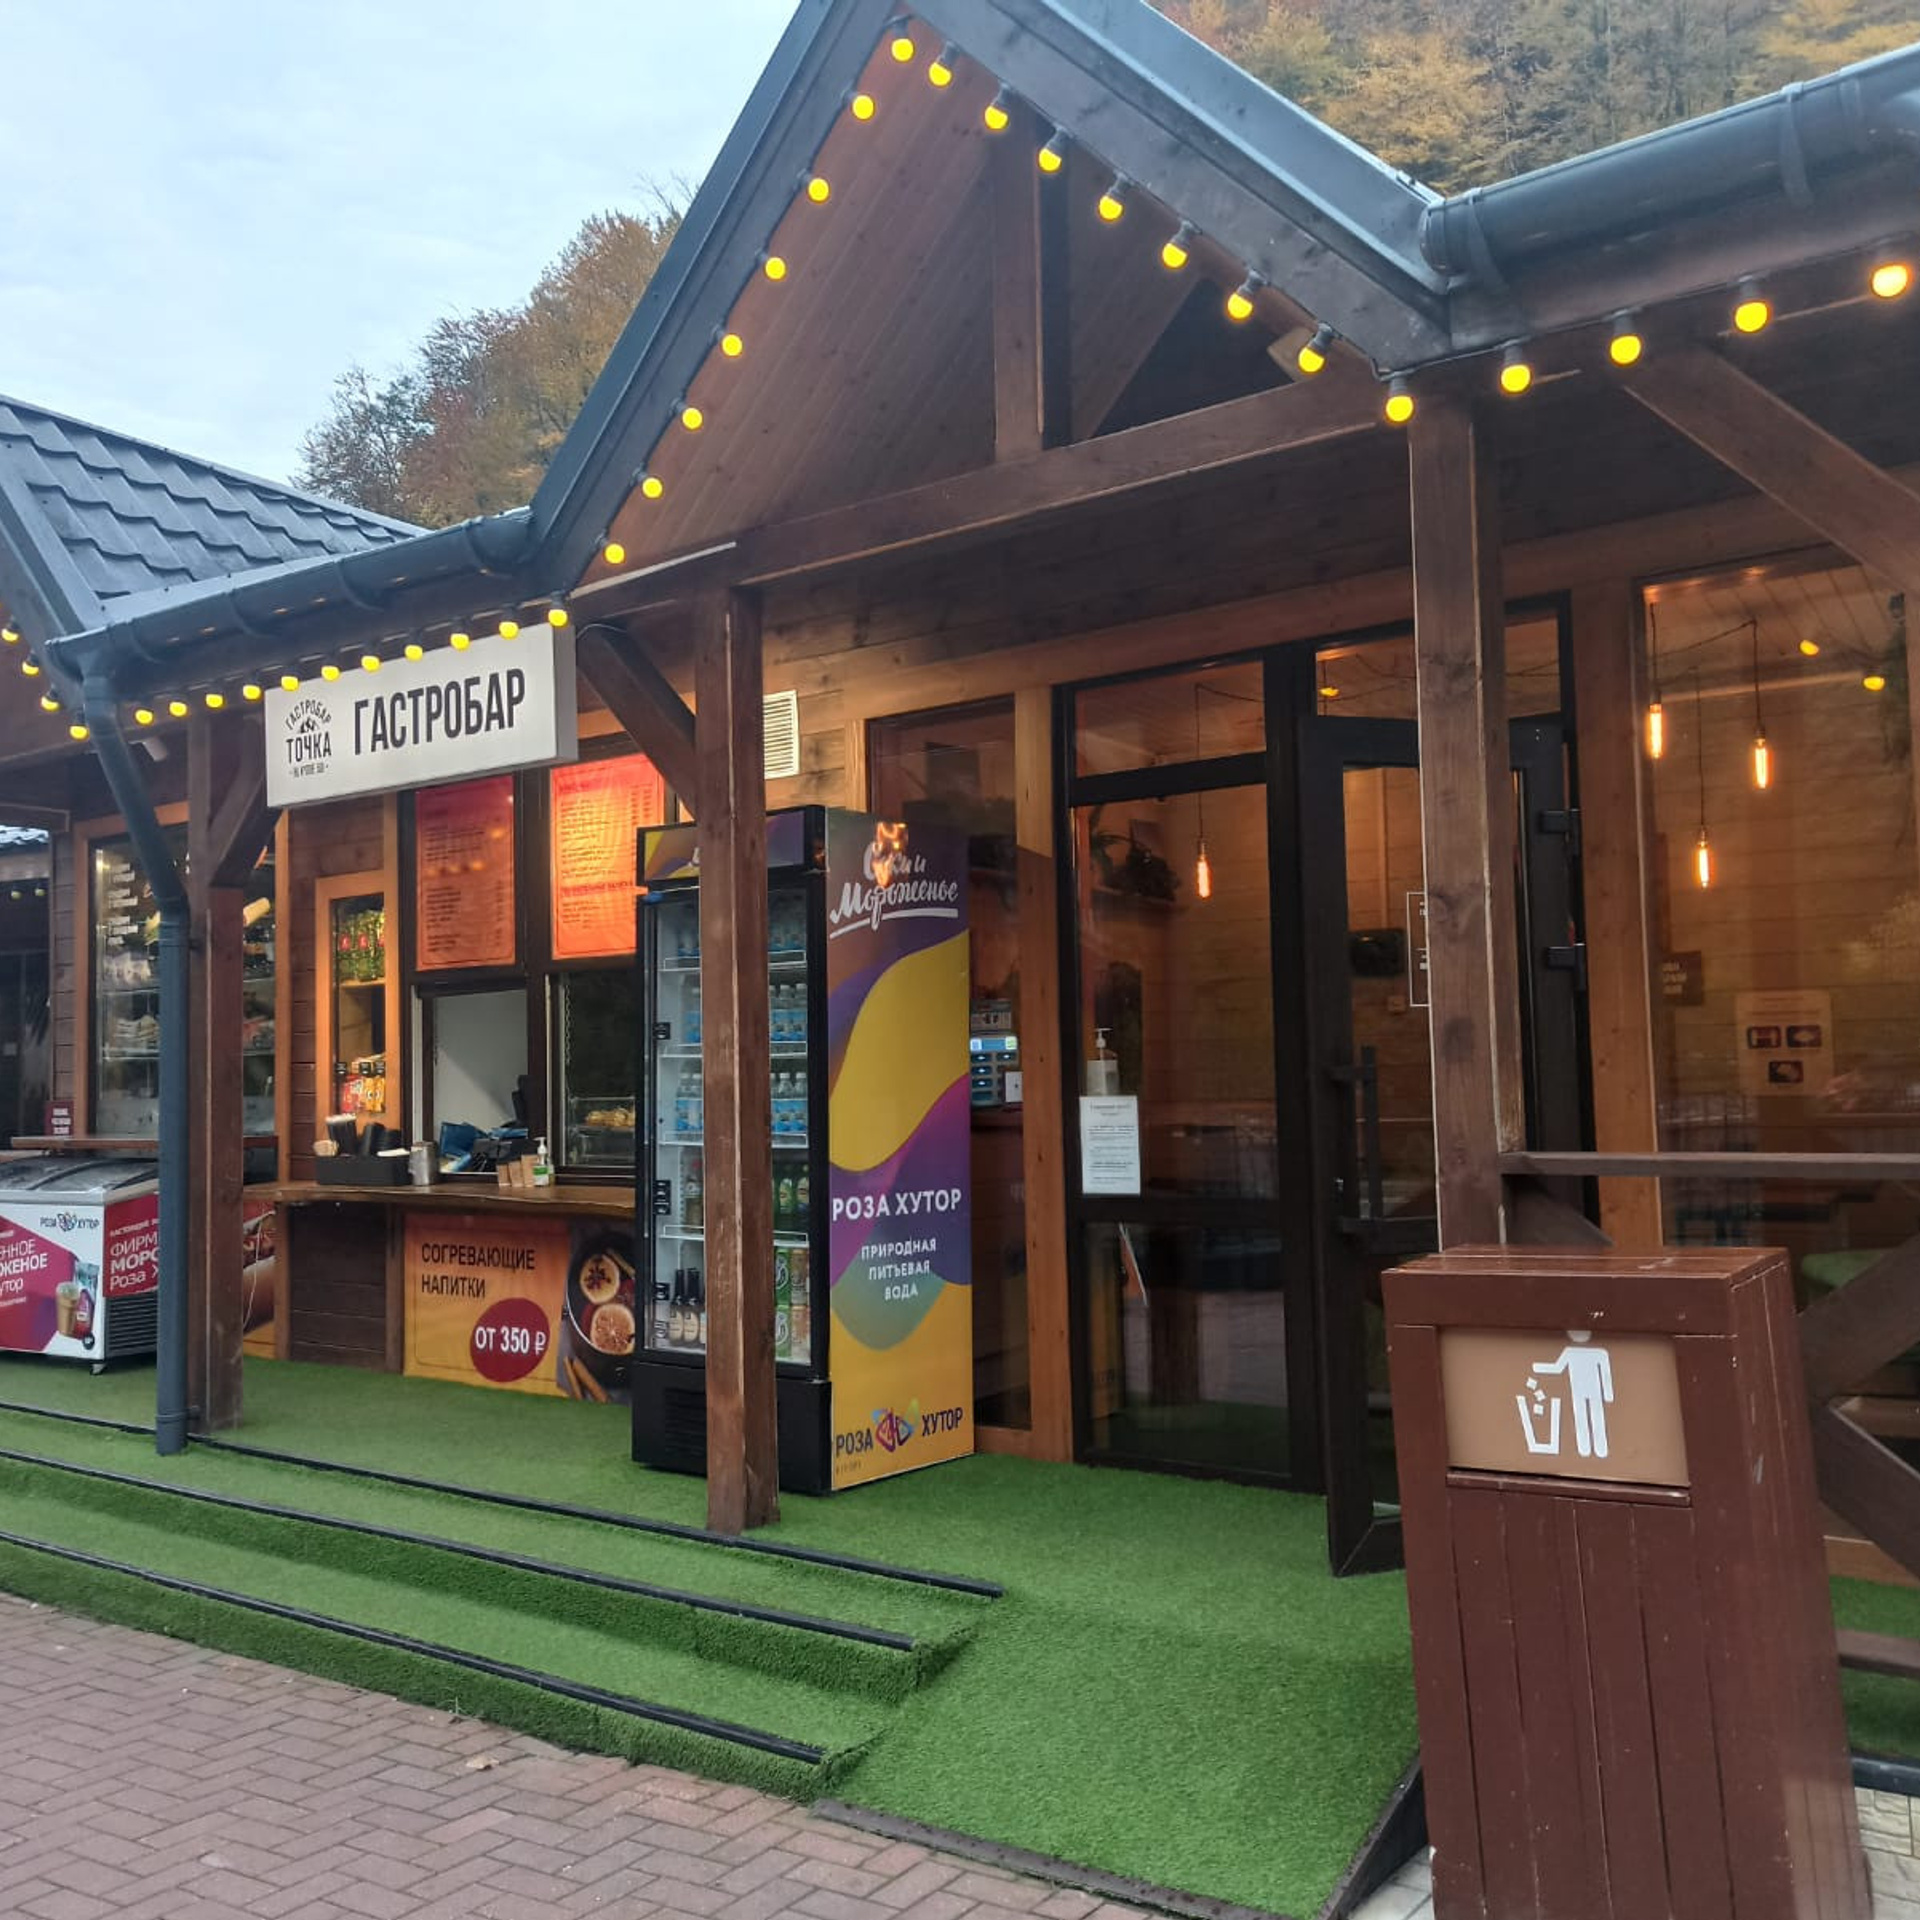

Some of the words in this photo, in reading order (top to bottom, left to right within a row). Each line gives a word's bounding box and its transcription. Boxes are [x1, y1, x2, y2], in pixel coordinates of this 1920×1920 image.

[286, 699, 332, 730] ГАСТРОБАР
[354, 668, 525, 755] ГАСТРОБАР
[286, 731, 332, 764] ТОЧКА
[915, 854, 926, 874] и
[829, 880, 958, 931] Мороженое
[832, 1194, 890, 1222] РОЗА
[895, 1188, 962, 1216] ХУТОР
[421, 1243, 535, 1273] СОГРЕВАЮЩИЕ
[861, 1238, 937, 1260] ПРИРОДНАЯ
[868, 1260, 931, 1281] ПИТЬЕВАЯ
[421, 1274, 486, 1298] НАПИТКИ
[884, 1282, 919, 1301] ВОДА
[475, 1326, 496, 1349] ОТ
[500, 1326, 530, 1353] 350
[836, 1428, 874, 1458] РОЗА
[921, 1407, 964, 1437] ХУТОР
